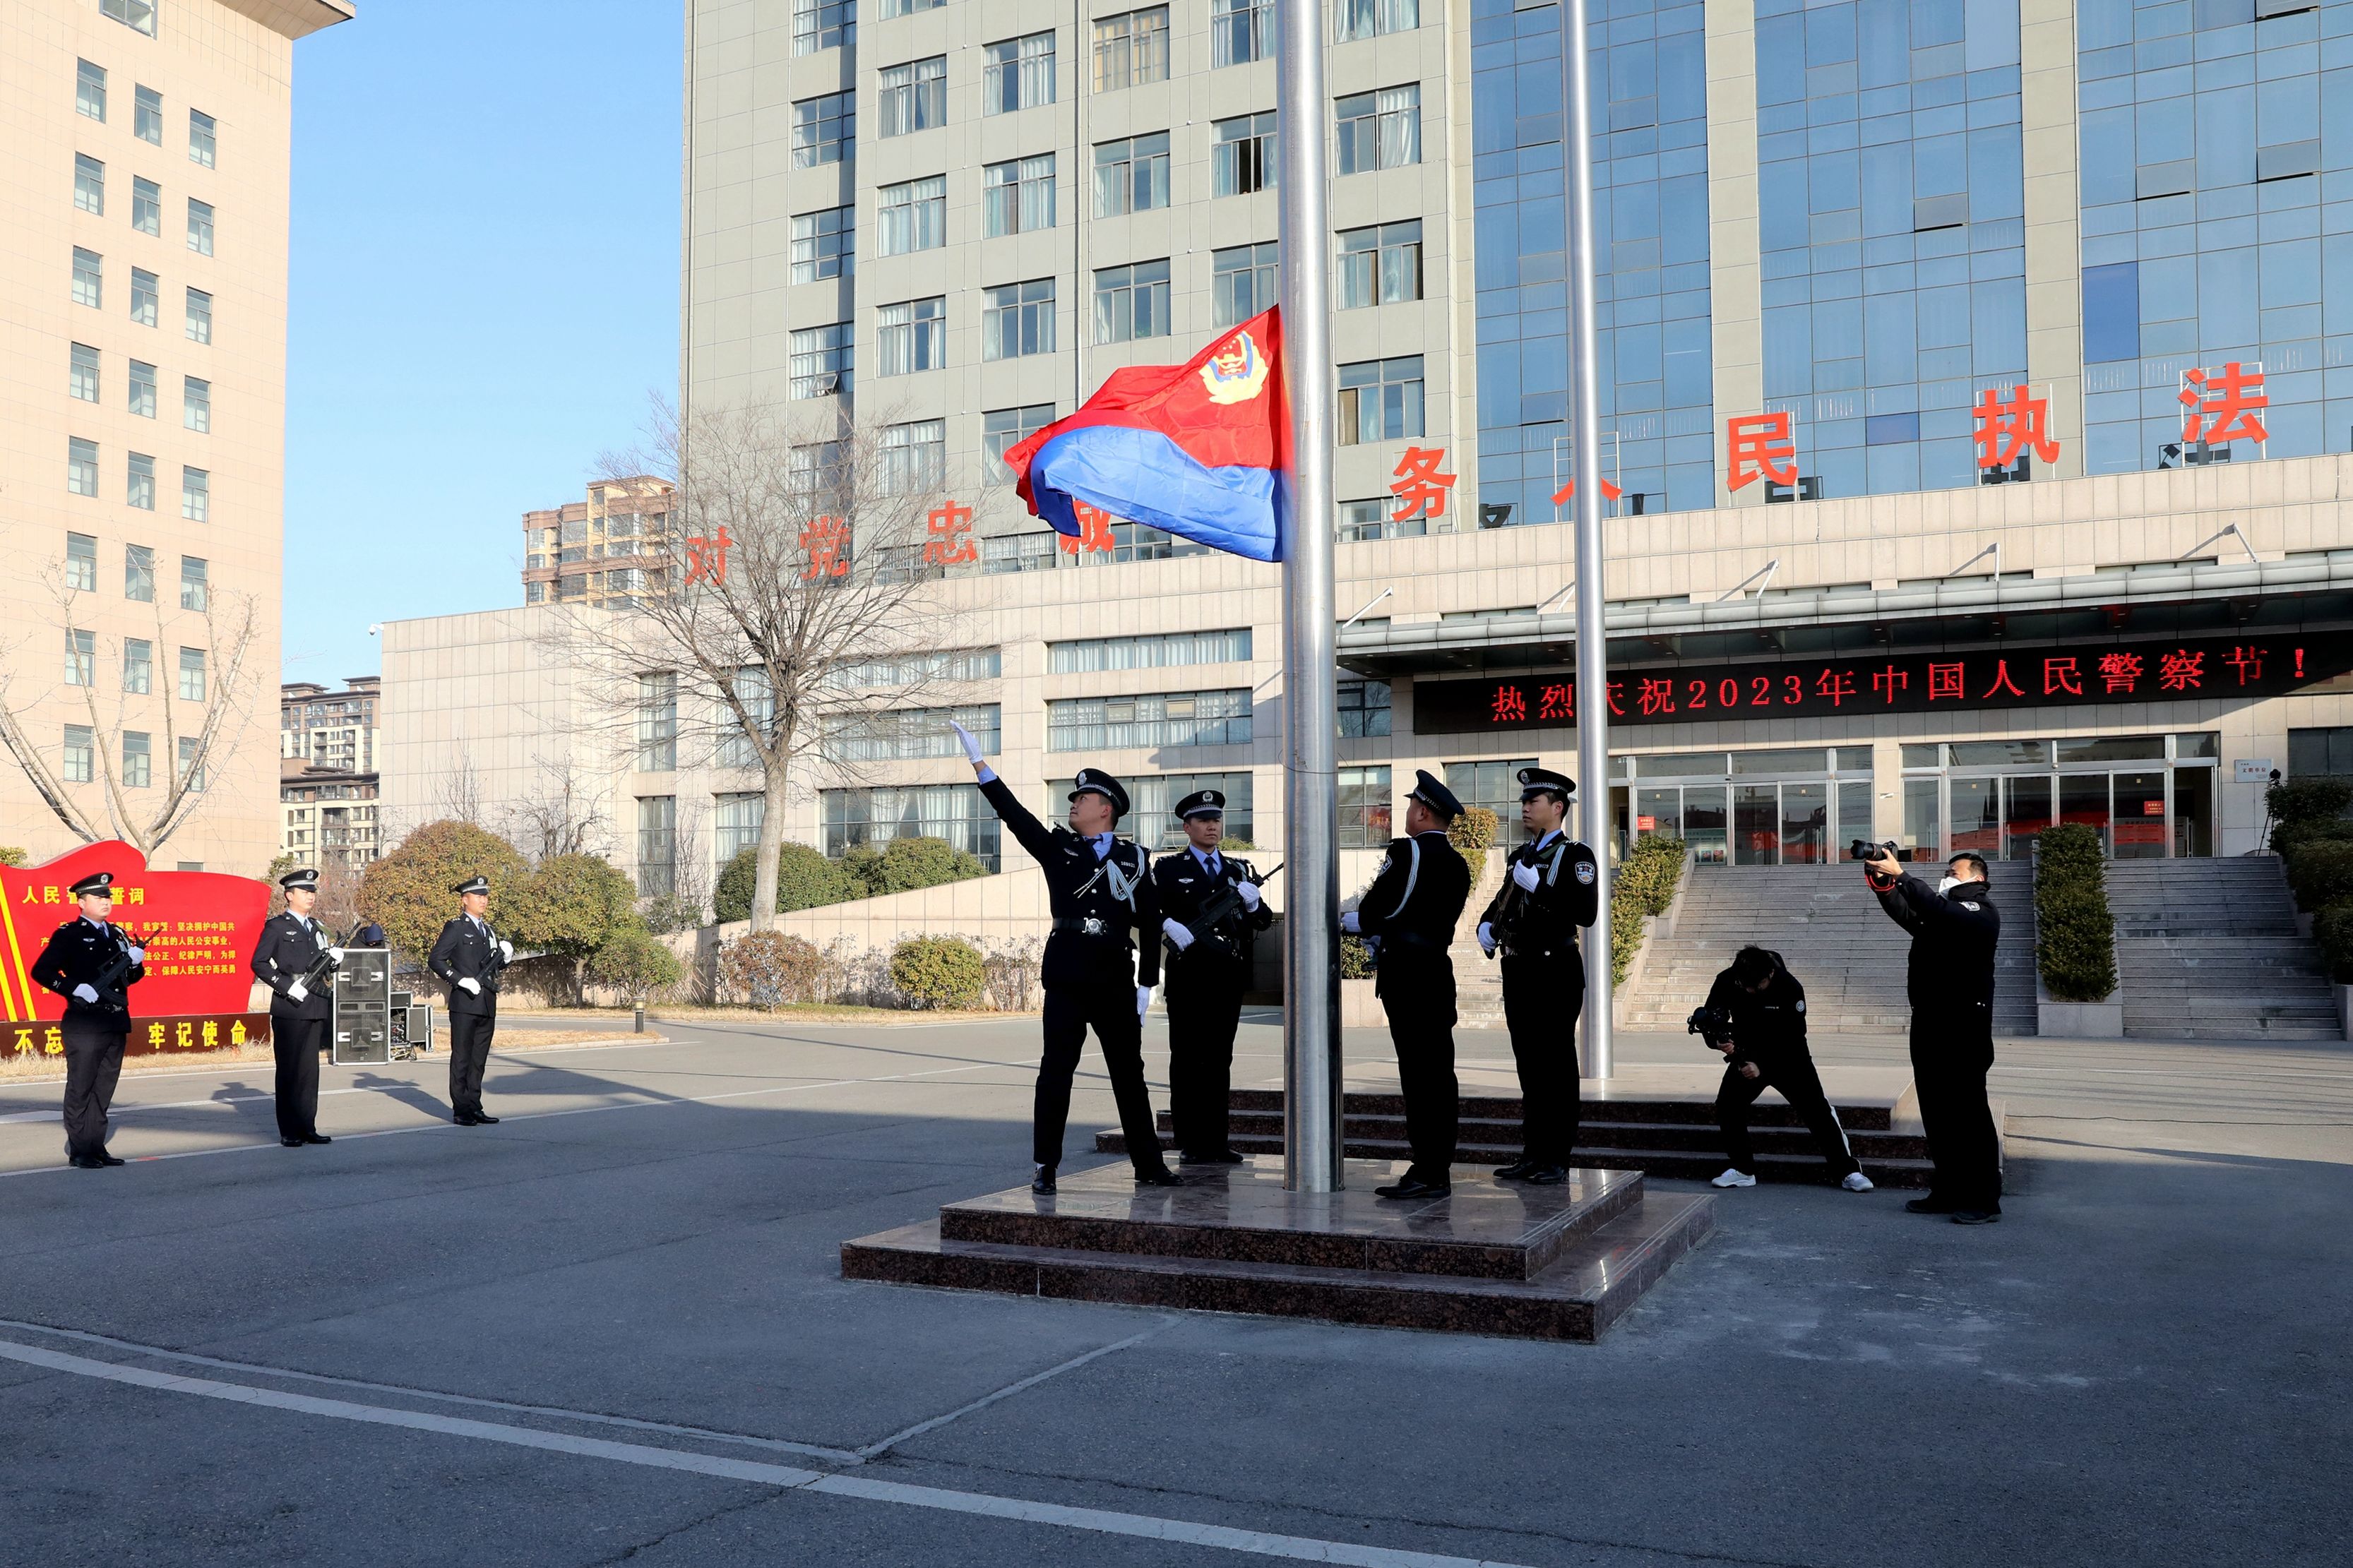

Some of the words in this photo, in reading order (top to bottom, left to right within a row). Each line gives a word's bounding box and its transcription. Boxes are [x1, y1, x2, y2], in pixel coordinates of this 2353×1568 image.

[1972, 361, 2269, 468] 执法
[22, 885, 144, 905] 人民誓词
[148, 1019, 246, 1050] 牢记使命
